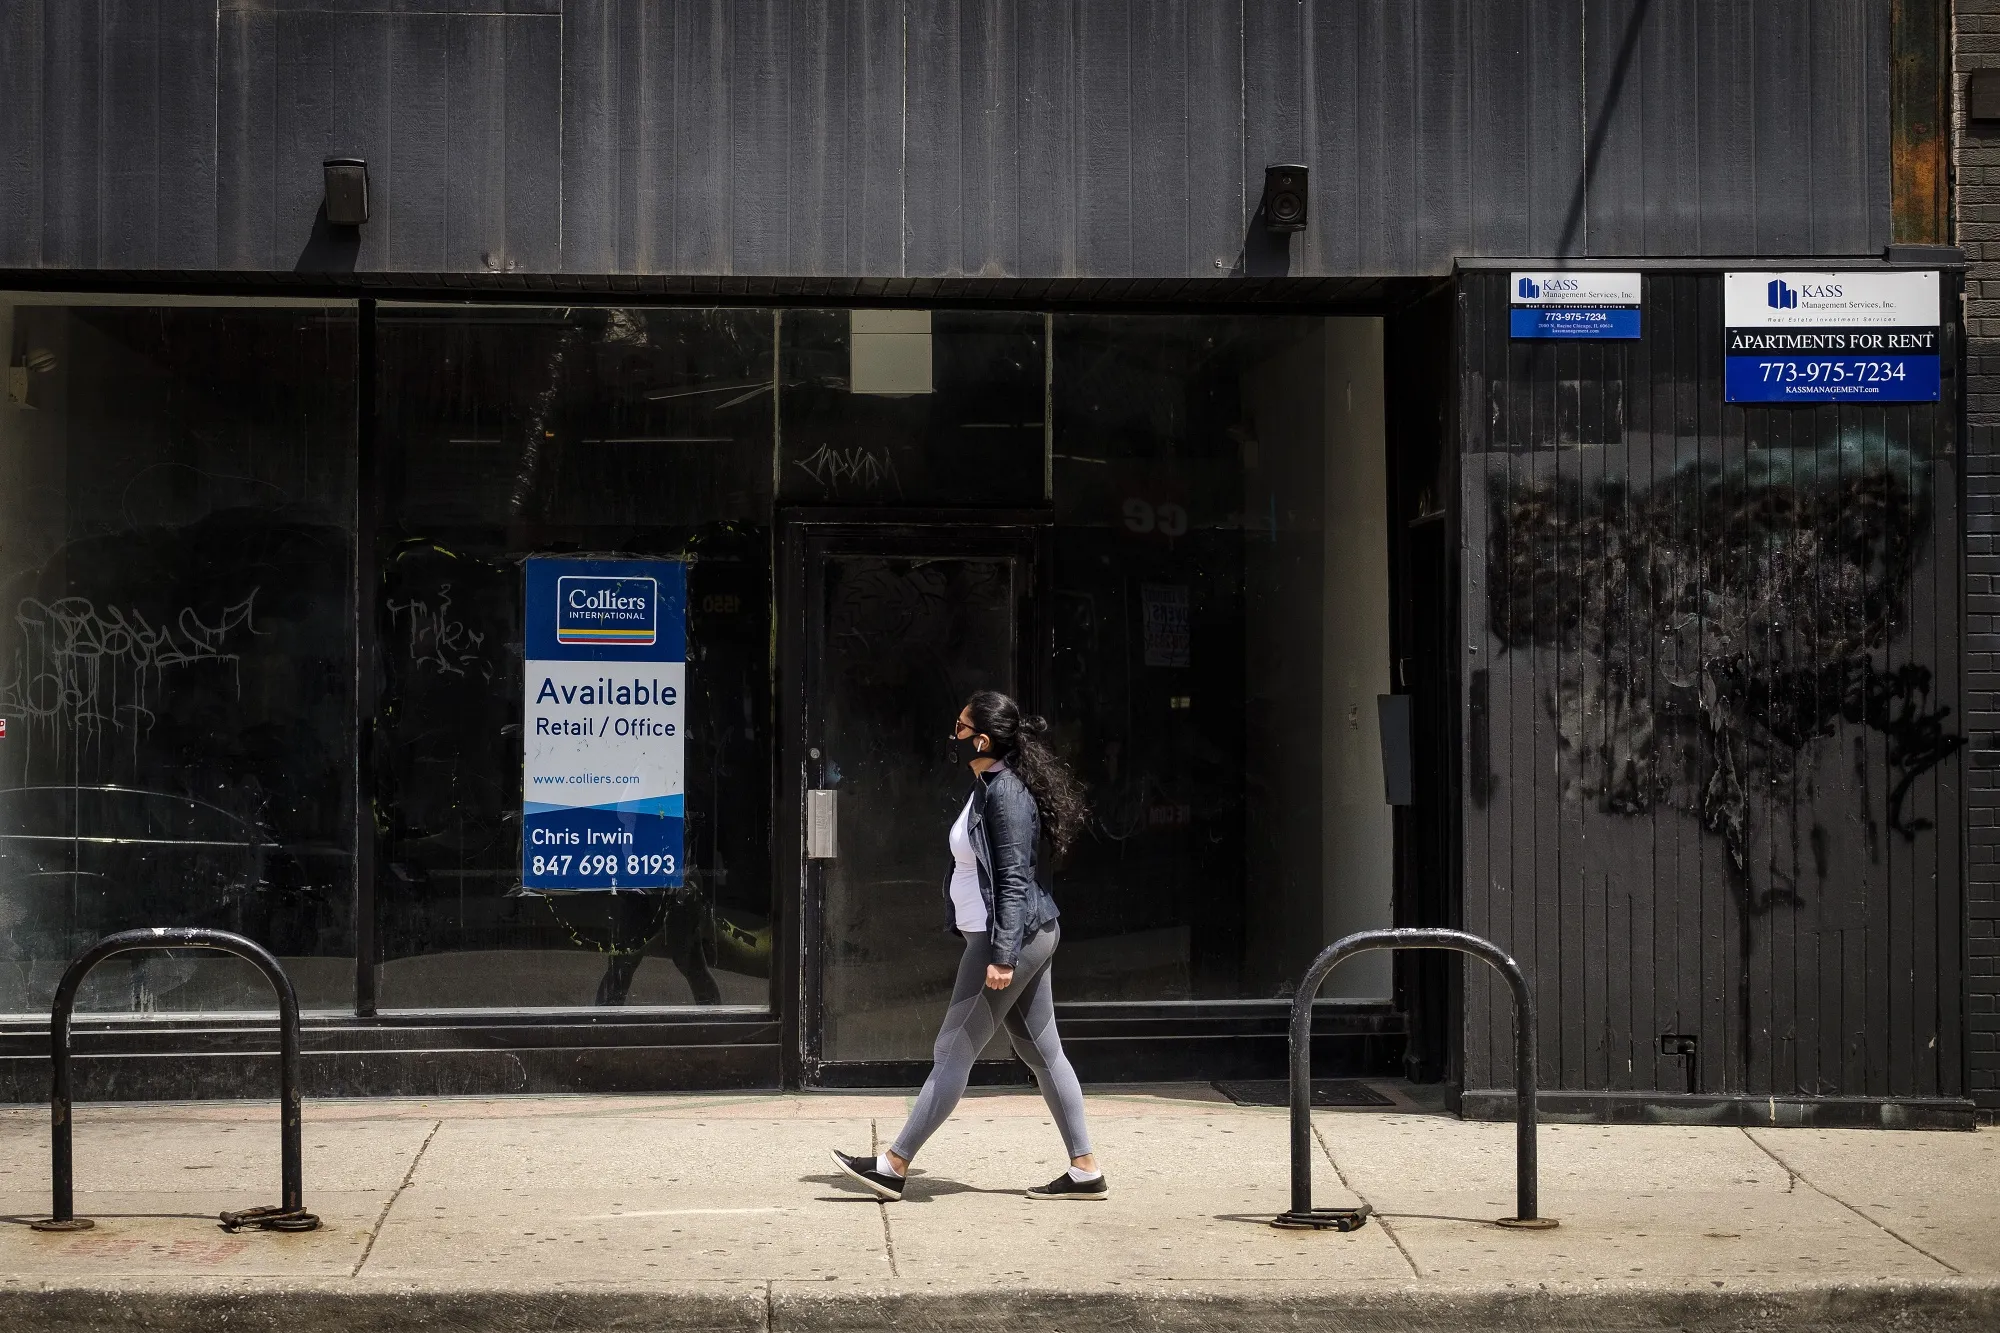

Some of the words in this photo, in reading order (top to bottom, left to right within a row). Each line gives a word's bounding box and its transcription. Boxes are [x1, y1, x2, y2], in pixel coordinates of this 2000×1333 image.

[1542, 279, 1578, 290] KASS
[1801, 284, 1844, 298] KASS
[1542, 291, 1586, 299] Management
[1588, 291, 1620, 299] Services,
[1621, 291, 1635, 299] Inc.
[1801, 301, 1847, 310] Management
[1849, 301, 1881, 309] Services,
[1882, 301, 1897, 309] Inc.
[1545, 312, 1607, 321] 773-975-7234
[1731, 334, 1846, 349] APARTMENTS
[1850, 334, 1884, 349] FOR
[1887, 333, 1935, 349] RENT
[1758, 362, 1906, 382] 773-975-7234
[1785, 386, 1880, 394] KASSMANAGEMENT.com
[568, 589, 646, 610] Colliers
[569, 611, 645, 620] INTERNATIONAL
[535, 677, 678, 706] Available
[536, 717, 594, 736] Retail
[614, 717, 676, 737] Office
[532, 773, 641, 785] www.colliers.com
[531, 828, 580, 845] Chris
[587, 827, 634, 845] Irwin
[532, 854, 573, 876] 847
[578, 854, 618, 876] 698
[626, 854, 675, 876] 8193
